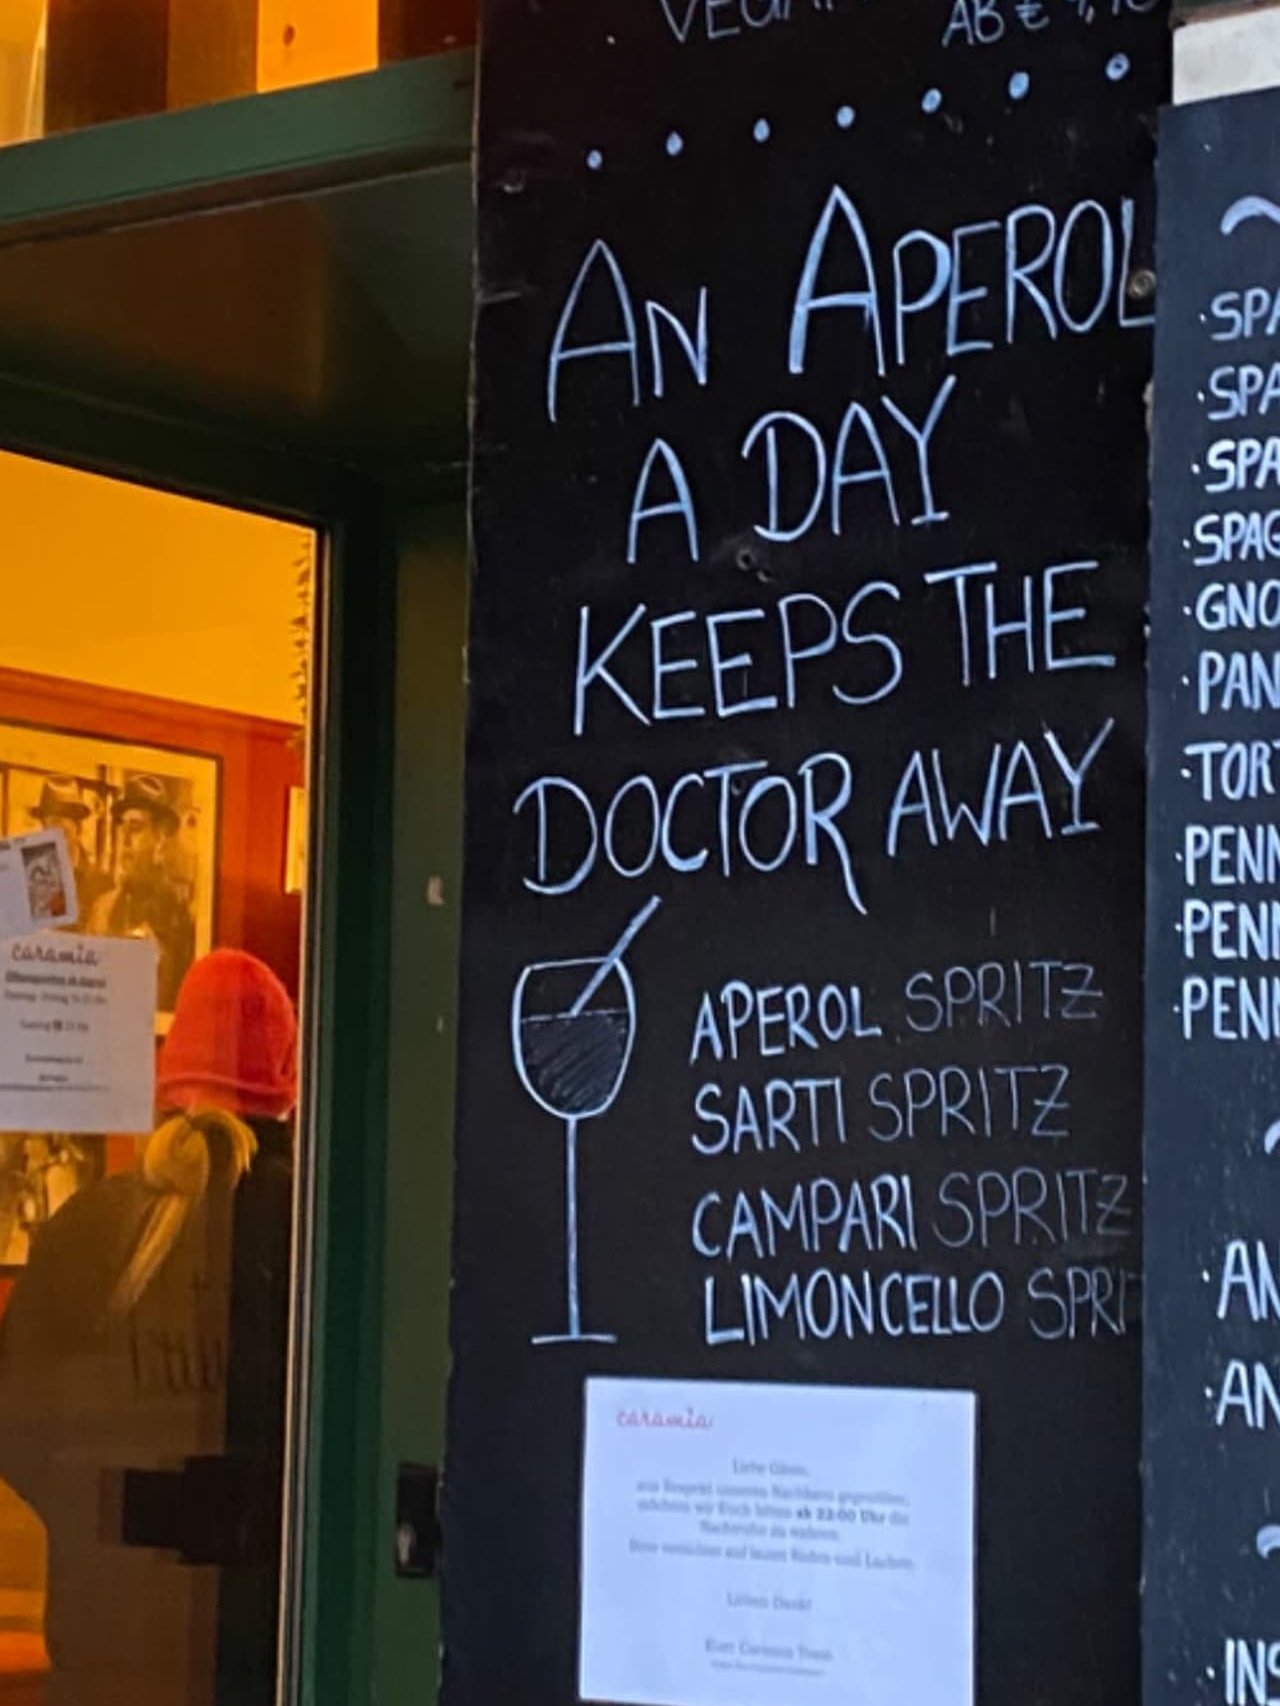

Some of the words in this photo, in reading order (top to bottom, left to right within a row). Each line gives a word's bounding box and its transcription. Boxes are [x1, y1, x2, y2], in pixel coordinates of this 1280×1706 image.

[627, 438, 699, 564] A
[742, 374, 956, 543] DAY
[574, 580, 903, 736] KEEPS
[925, 562, 1116, 686] THE
[513, 752, 868, 916] DOCTOR
[887, 718, 1115, 857] AWAY
[689, 981, 882, 1066] APEROL
[905, 959, 1103, 1033] SPRITZ
[690, 1076, 847, 1155] SARTI
[867, 1063, 1069, 1141] SPRITZ
[690, 1173, 918, 1260] CAMPARI
[931, 1167, 1132, 1249] SPRITZ
[705, 1269, 1005, 1347] LIMONCELLO
[1026, 1264, 1144, 1341] SPRI
